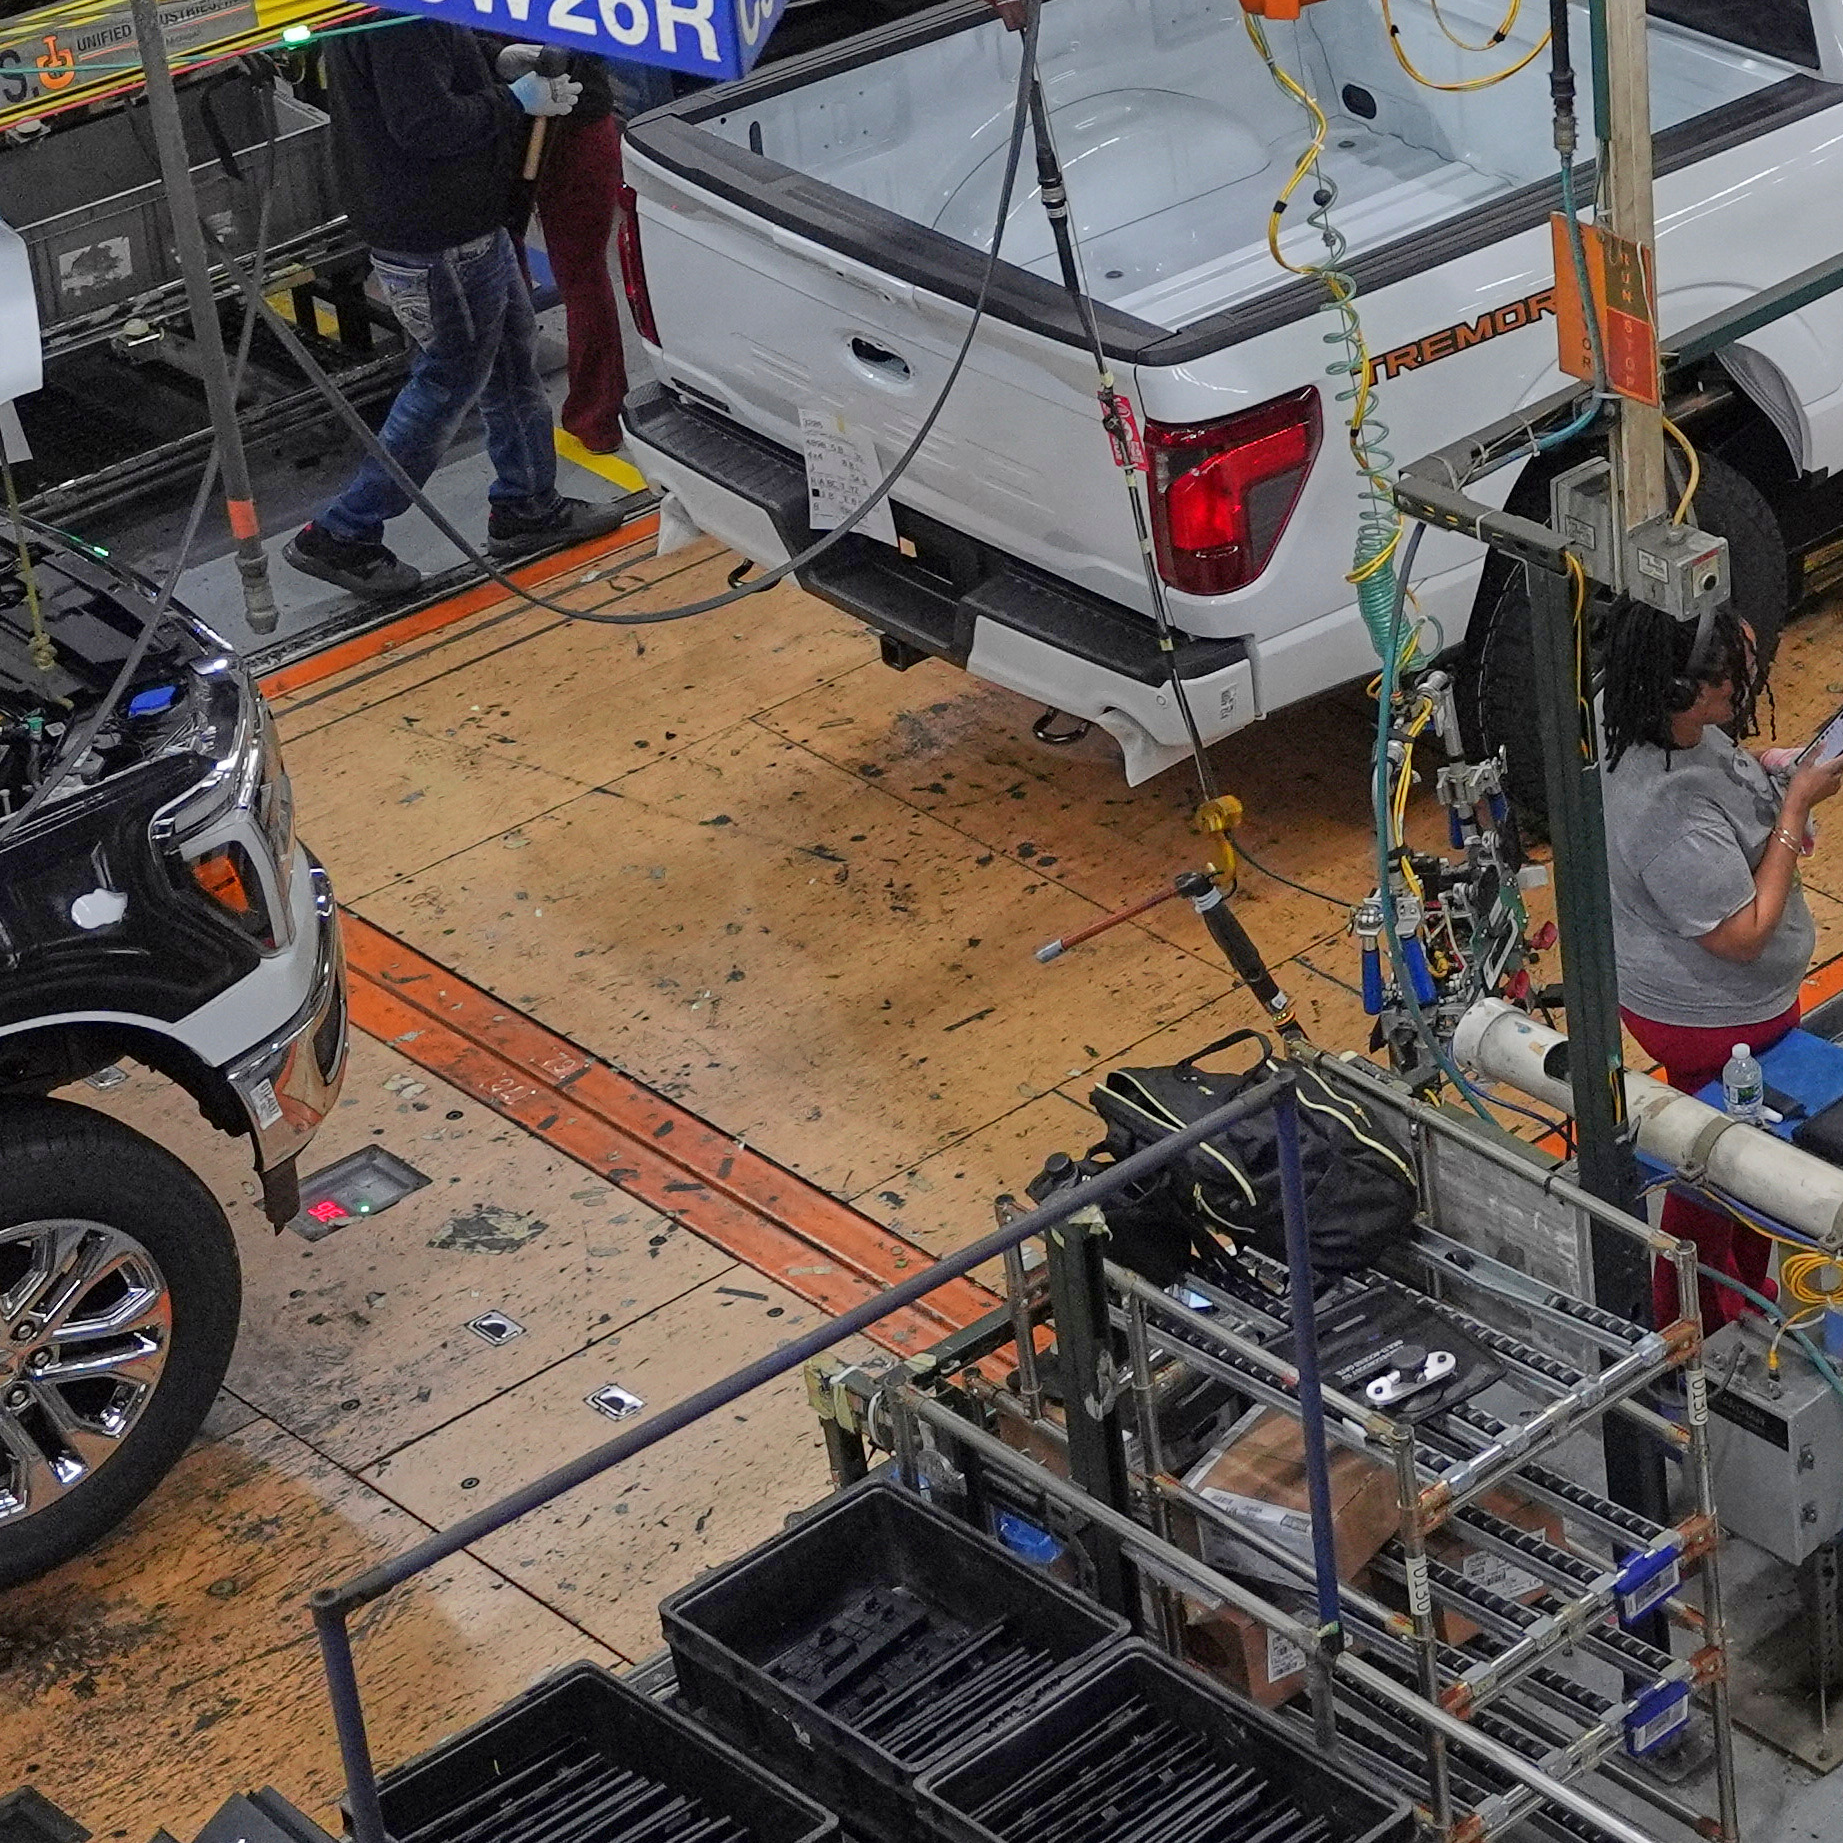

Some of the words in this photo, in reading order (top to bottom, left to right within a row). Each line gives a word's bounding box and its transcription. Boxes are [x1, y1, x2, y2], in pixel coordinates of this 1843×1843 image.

[76, 23, 133, 52] UNIFIED
[1620, 250, 1635, 303] RUN
[1351, 286, 1557, 389] TREMOR
[1622, 318, 1637, 389] STOP
